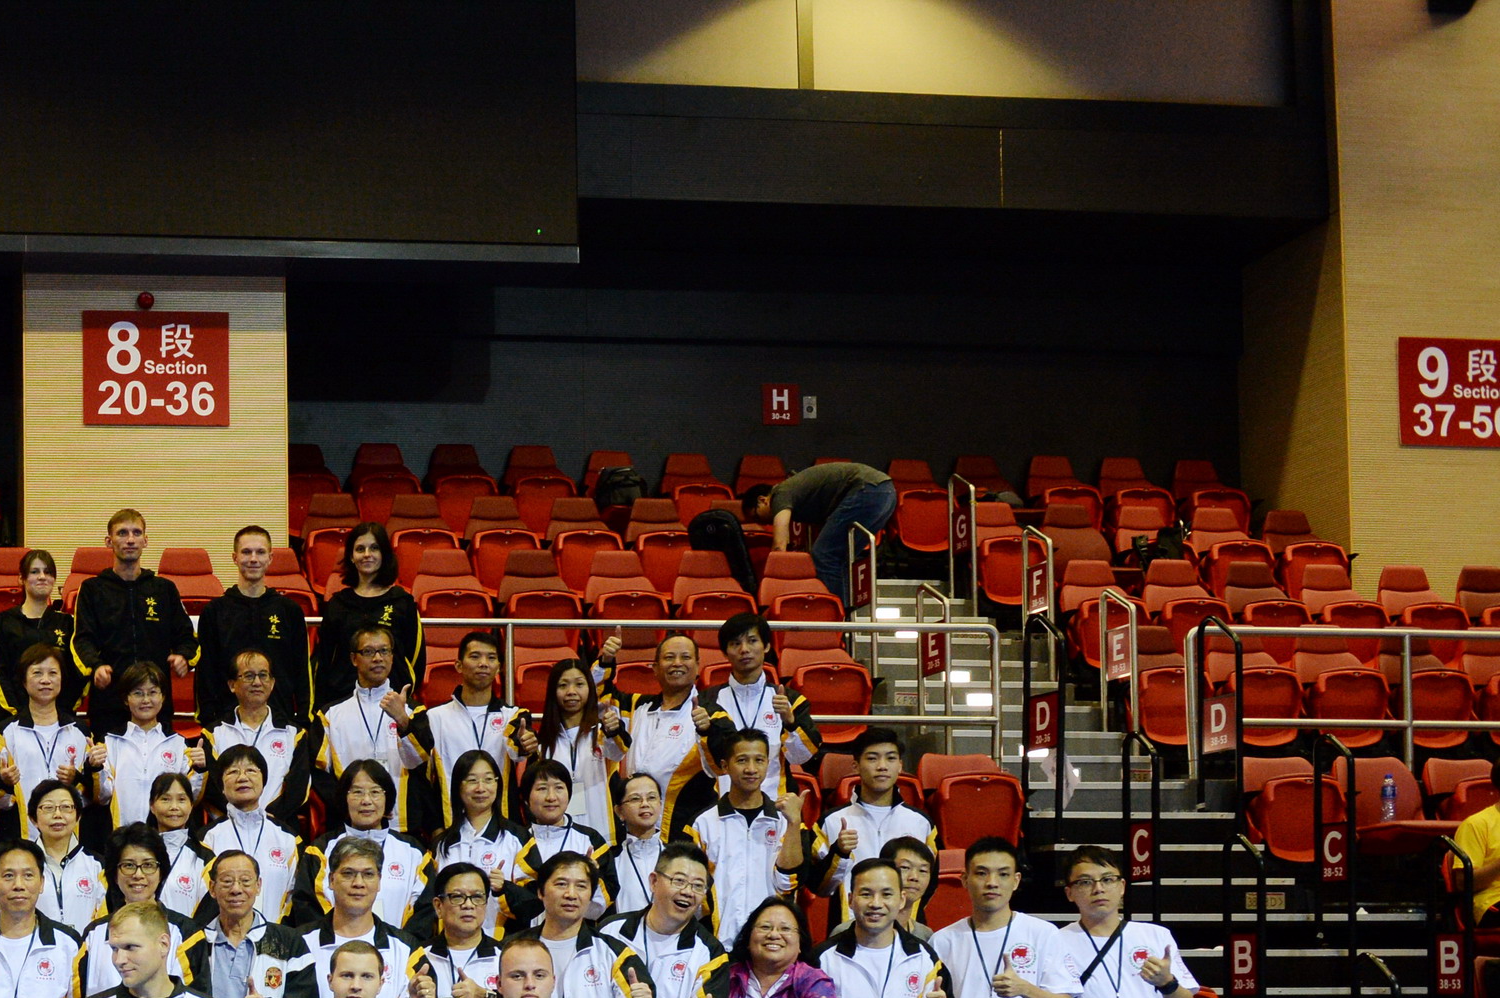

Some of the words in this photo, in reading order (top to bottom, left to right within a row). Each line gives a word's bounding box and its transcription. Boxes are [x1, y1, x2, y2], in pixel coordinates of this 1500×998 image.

[107, 321, 141, 374] 8
[160, 323, 194, 358] 段
[144, 360, 207, 375] Section
[1417, 347, 1449, 398] 9
[1467, 349, 1497, 383] 段
[98, 380, 215, 416] 20-36
[772, 389, 789, 410] H
[1453, 384, 1500, 399] Sectio
[1413, 403, 1500, 438] 37-5
[956, 514, 967, 539] G
[857, 564, 866, 591] F
[1032, 569, 1043, 596] F
[928, 632, 938, 658] E
[1112, 633, 1124, 661] E
[1036, 701, 1050, 732] D
[1210, 703, 1227, 733] D
[1132, 829, 1149, 862] C
[1324, 831, 1343, 864] C
[1323, 867, 1343, 877] 38-52
[1234, 940, 1252, 974] B
[1440, 940, 1460, 974] B
[1234, 979, 1255, 989] 20-36
[1439, 979, 1461, 989] 38-53
